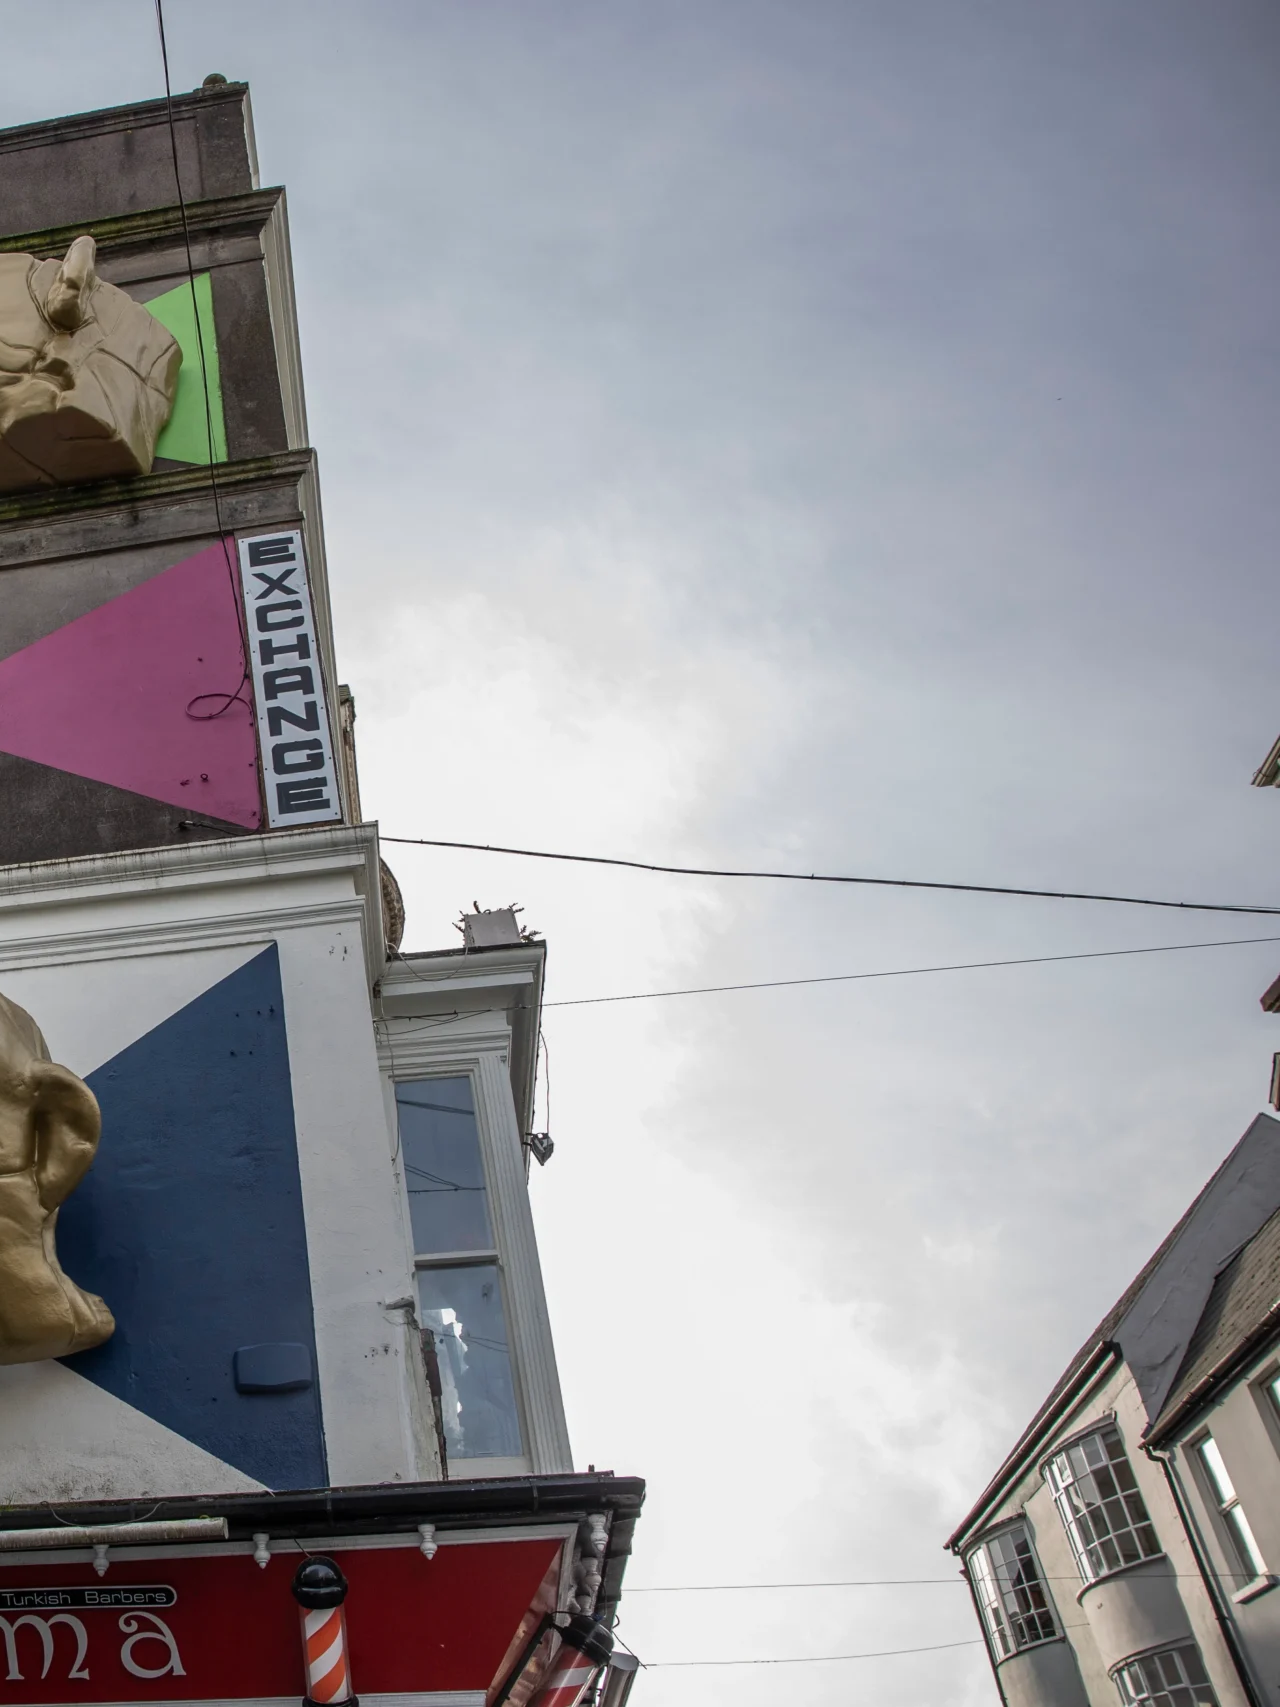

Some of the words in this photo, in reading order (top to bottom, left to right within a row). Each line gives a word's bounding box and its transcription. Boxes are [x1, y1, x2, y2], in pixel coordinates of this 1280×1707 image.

[247, 536, 330, 815] EXCHANGE
[1, 1591, 71, 1608] Turkish
[84, 1590, 167, 1605] Barbers
